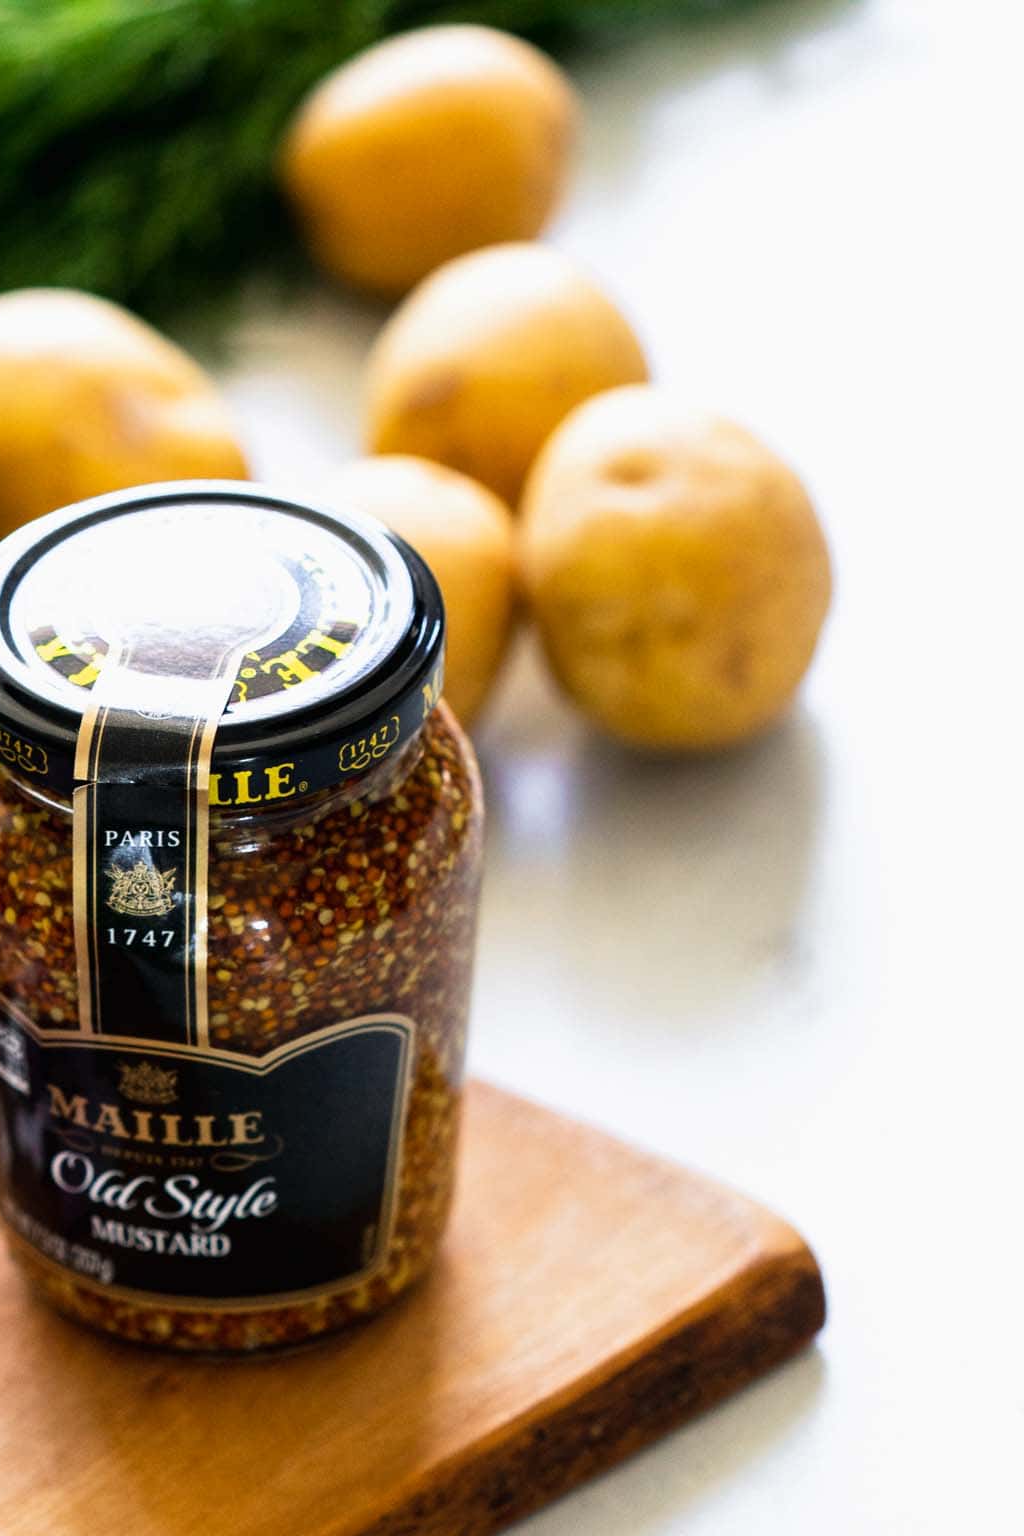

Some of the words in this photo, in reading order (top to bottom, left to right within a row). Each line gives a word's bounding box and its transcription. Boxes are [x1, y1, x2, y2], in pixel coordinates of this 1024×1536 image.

[104, 830, 180, 847] PARIS
[107, 928, 175, 947] 1747
[48, 1084, 265, 1146] MAILLE
[50, 1150, 156, 1210] Old
[144, 1174, 277, 1232] Style
[90, 1215, 231, 1257] MUSTARD
